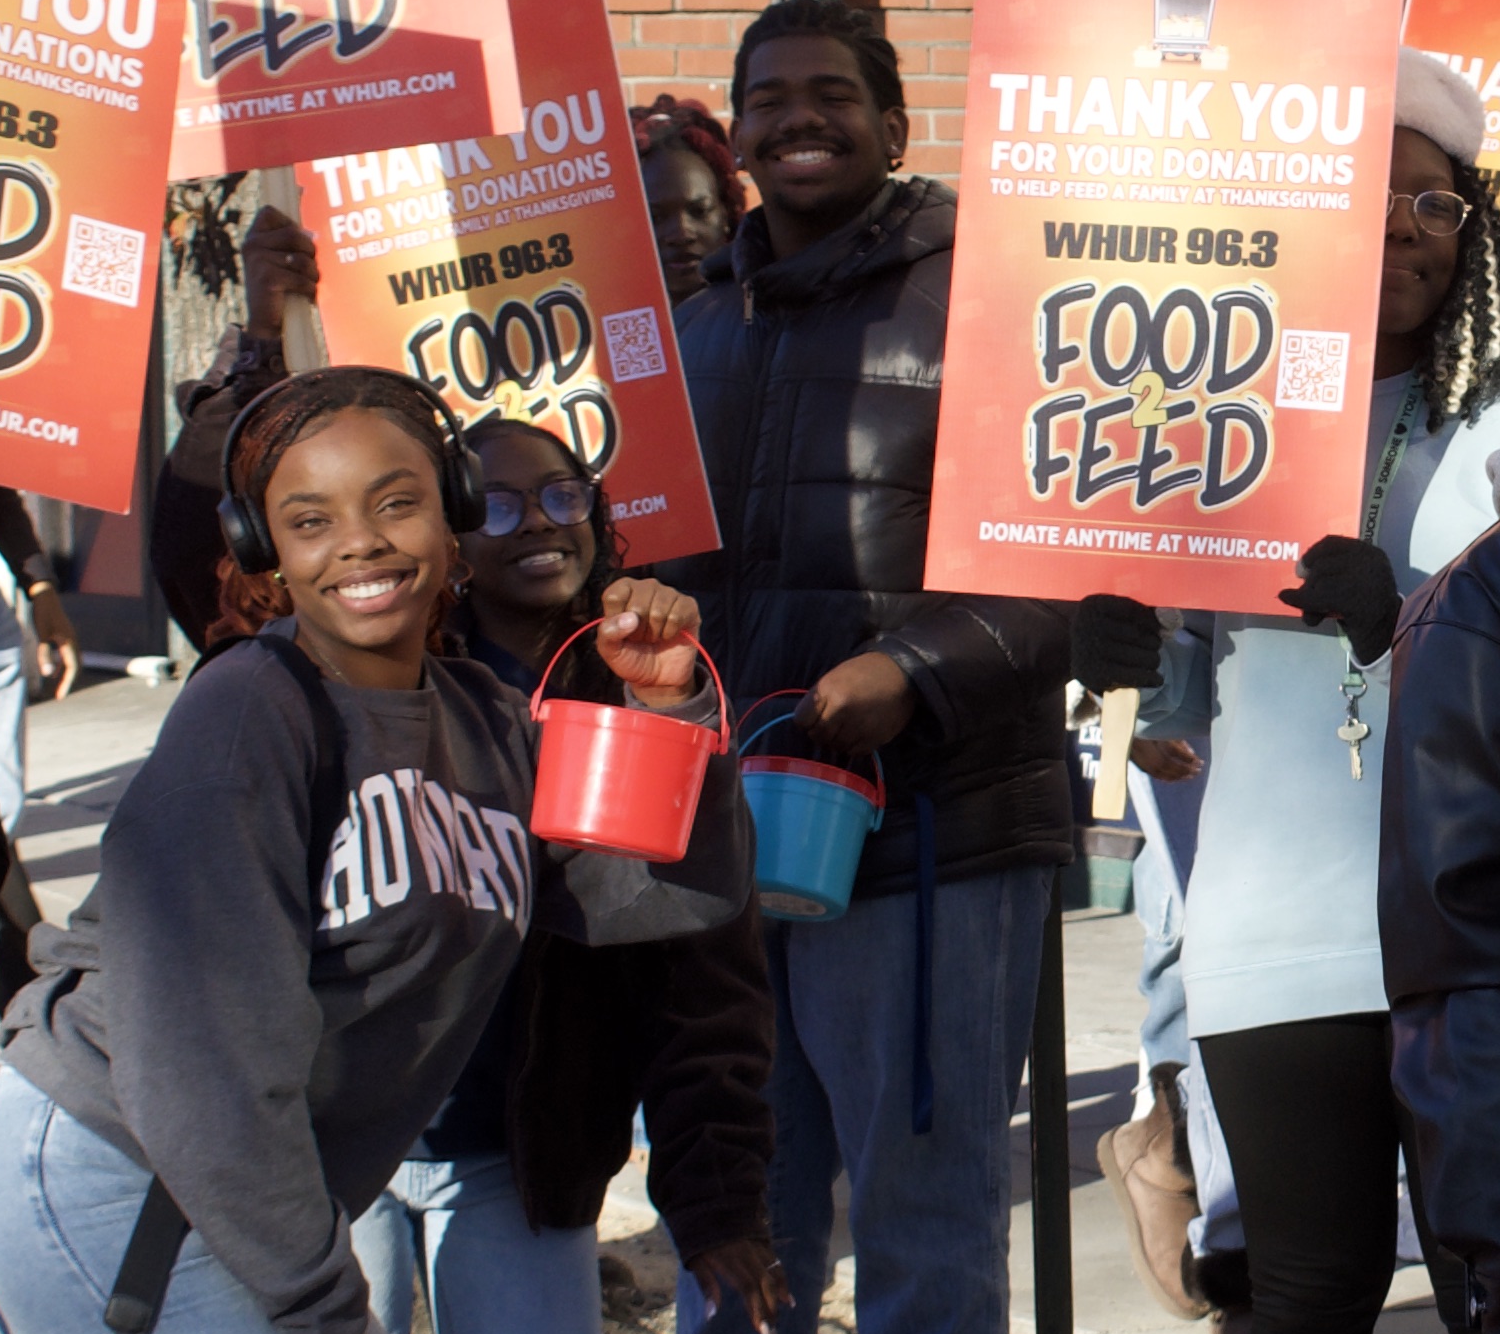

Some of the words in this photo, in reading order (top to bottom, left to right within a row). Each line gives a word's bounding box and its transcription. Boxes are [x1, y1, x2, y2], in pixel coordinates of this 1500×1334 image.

[197, 92, 296, 125] ANYTIME
[300, 87, 328, 110] AT
[330, 69, 456, 105] WHUR.COM
[989, 71, 1214, 140] THANK
[1229, 80, 1369, 147] YOU
[989, 139, 1058, 174] FOR
[1063, 142, 1155, 178] YOUR
[1159, 146, 1355, 187] DONATIONS
[330, 205, 385, 243] FOR
[383, 187, 459, 229] YOUR
[458, 149, 613, 212] DONATIONS
[988, 176, 1014, 196] TO
[1015, 177, 1062, 198] HELP
[1062, 179, 1109, 200] FEED
[1109, 181, 1125, 201] A
[1126, 182, 1190, 204] FAMILY
[1190, 185, 1216, 205] AT
[1217, 186, 1351, 211] THANKSGIVING
[386, 249, 501, 306] WHUR
[497, 230, 576, 281] 96.3
[1041, 219, 1180, 266] WHUR
[1182, 225, 1280, 270] 96.3
[1039, 281, 1277, 397] FOOD
[1028, 393, 1270, 510] FEED
[1378, 435, 1402, 484] SOMEONE
[610, 493, 668, 521] R.COM
[977, 520, 1061, 546] DONATE
[1061, 525, 1153, 551] ANYTIME
[1155, 532, 1184, 553] AT
[1186, 533, 1300, 561] WHUR.COM
